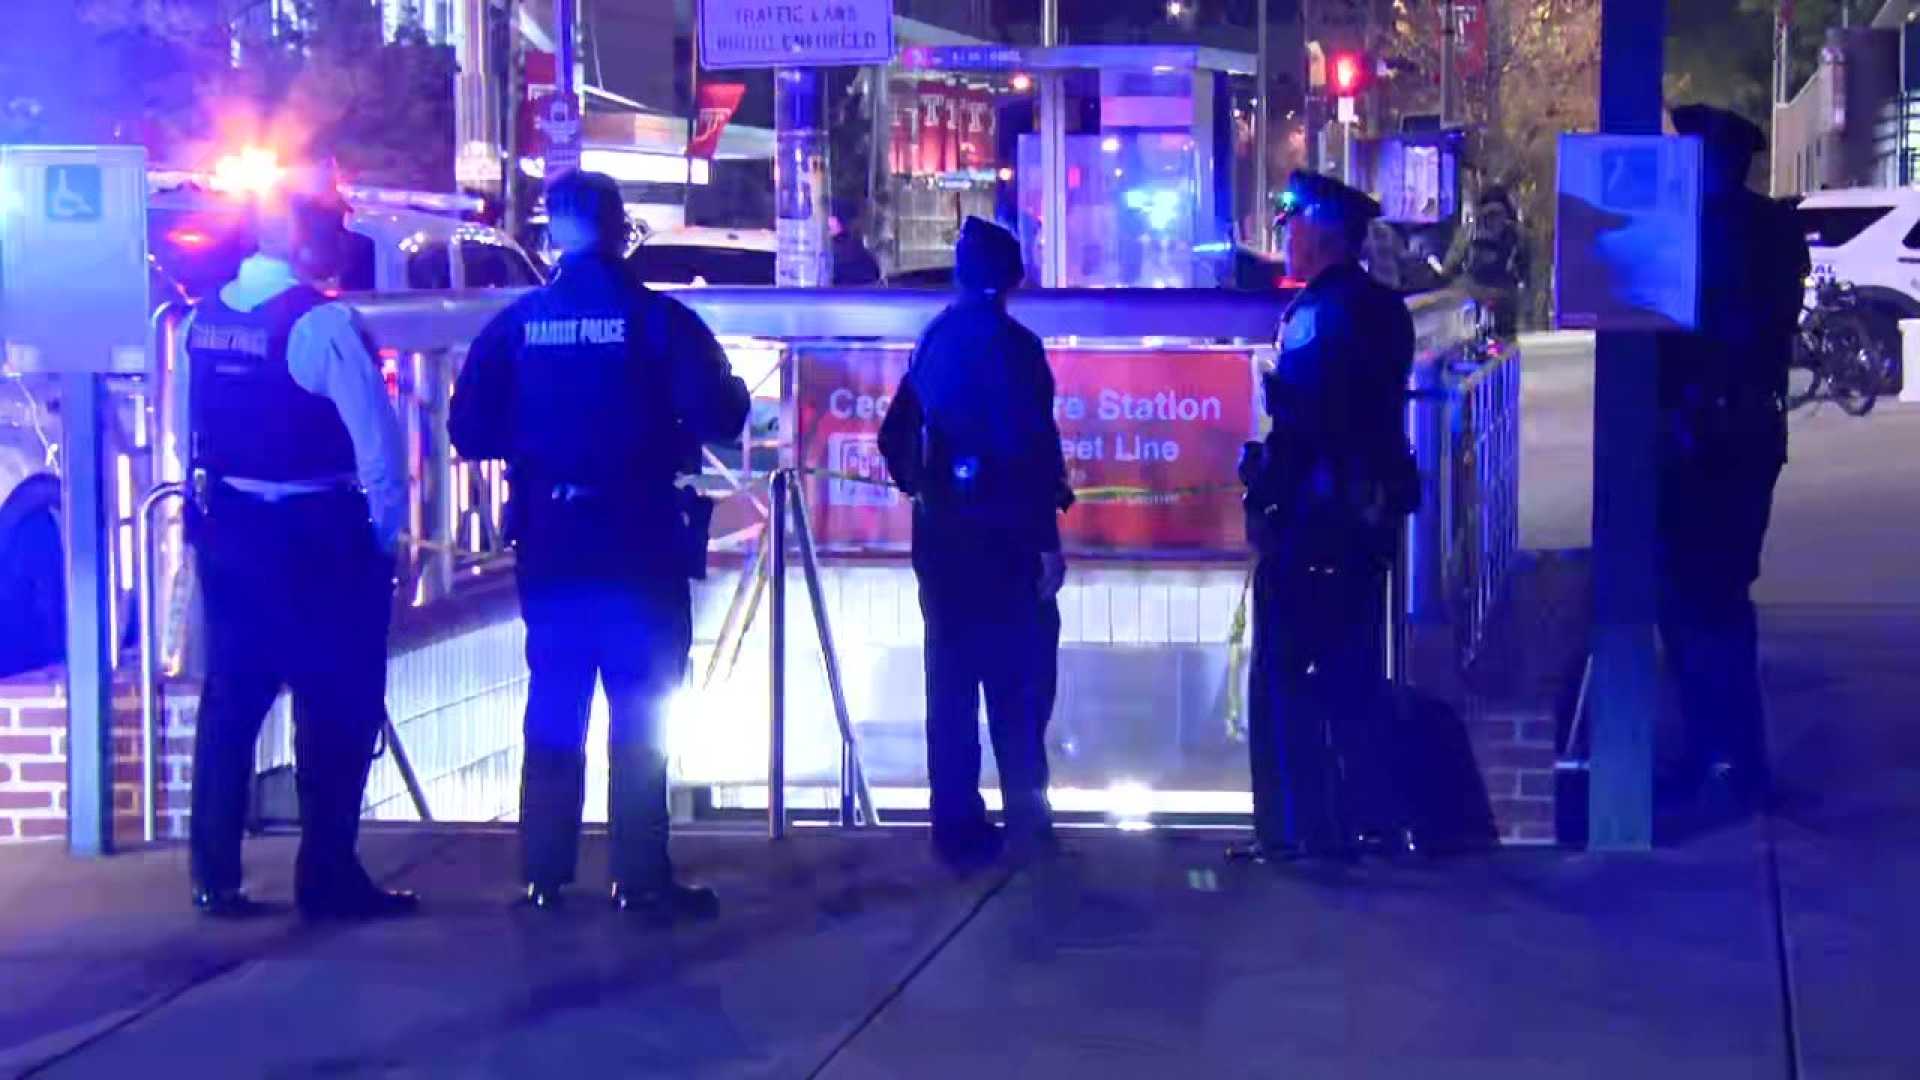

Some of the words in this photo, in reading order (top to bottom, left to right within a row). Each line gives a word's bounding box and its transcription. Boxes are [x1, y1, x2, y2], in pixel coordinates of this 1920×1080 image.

[580, 318, 625, 343] POLICE
[829, 388, 893, 419] Cec
[1053, 396, 1086, 420] re
[1098, 389, 1222, 421] Station
[1061, 434, 1103, 460] eet
[1115, 434, 1181, 461] Line
